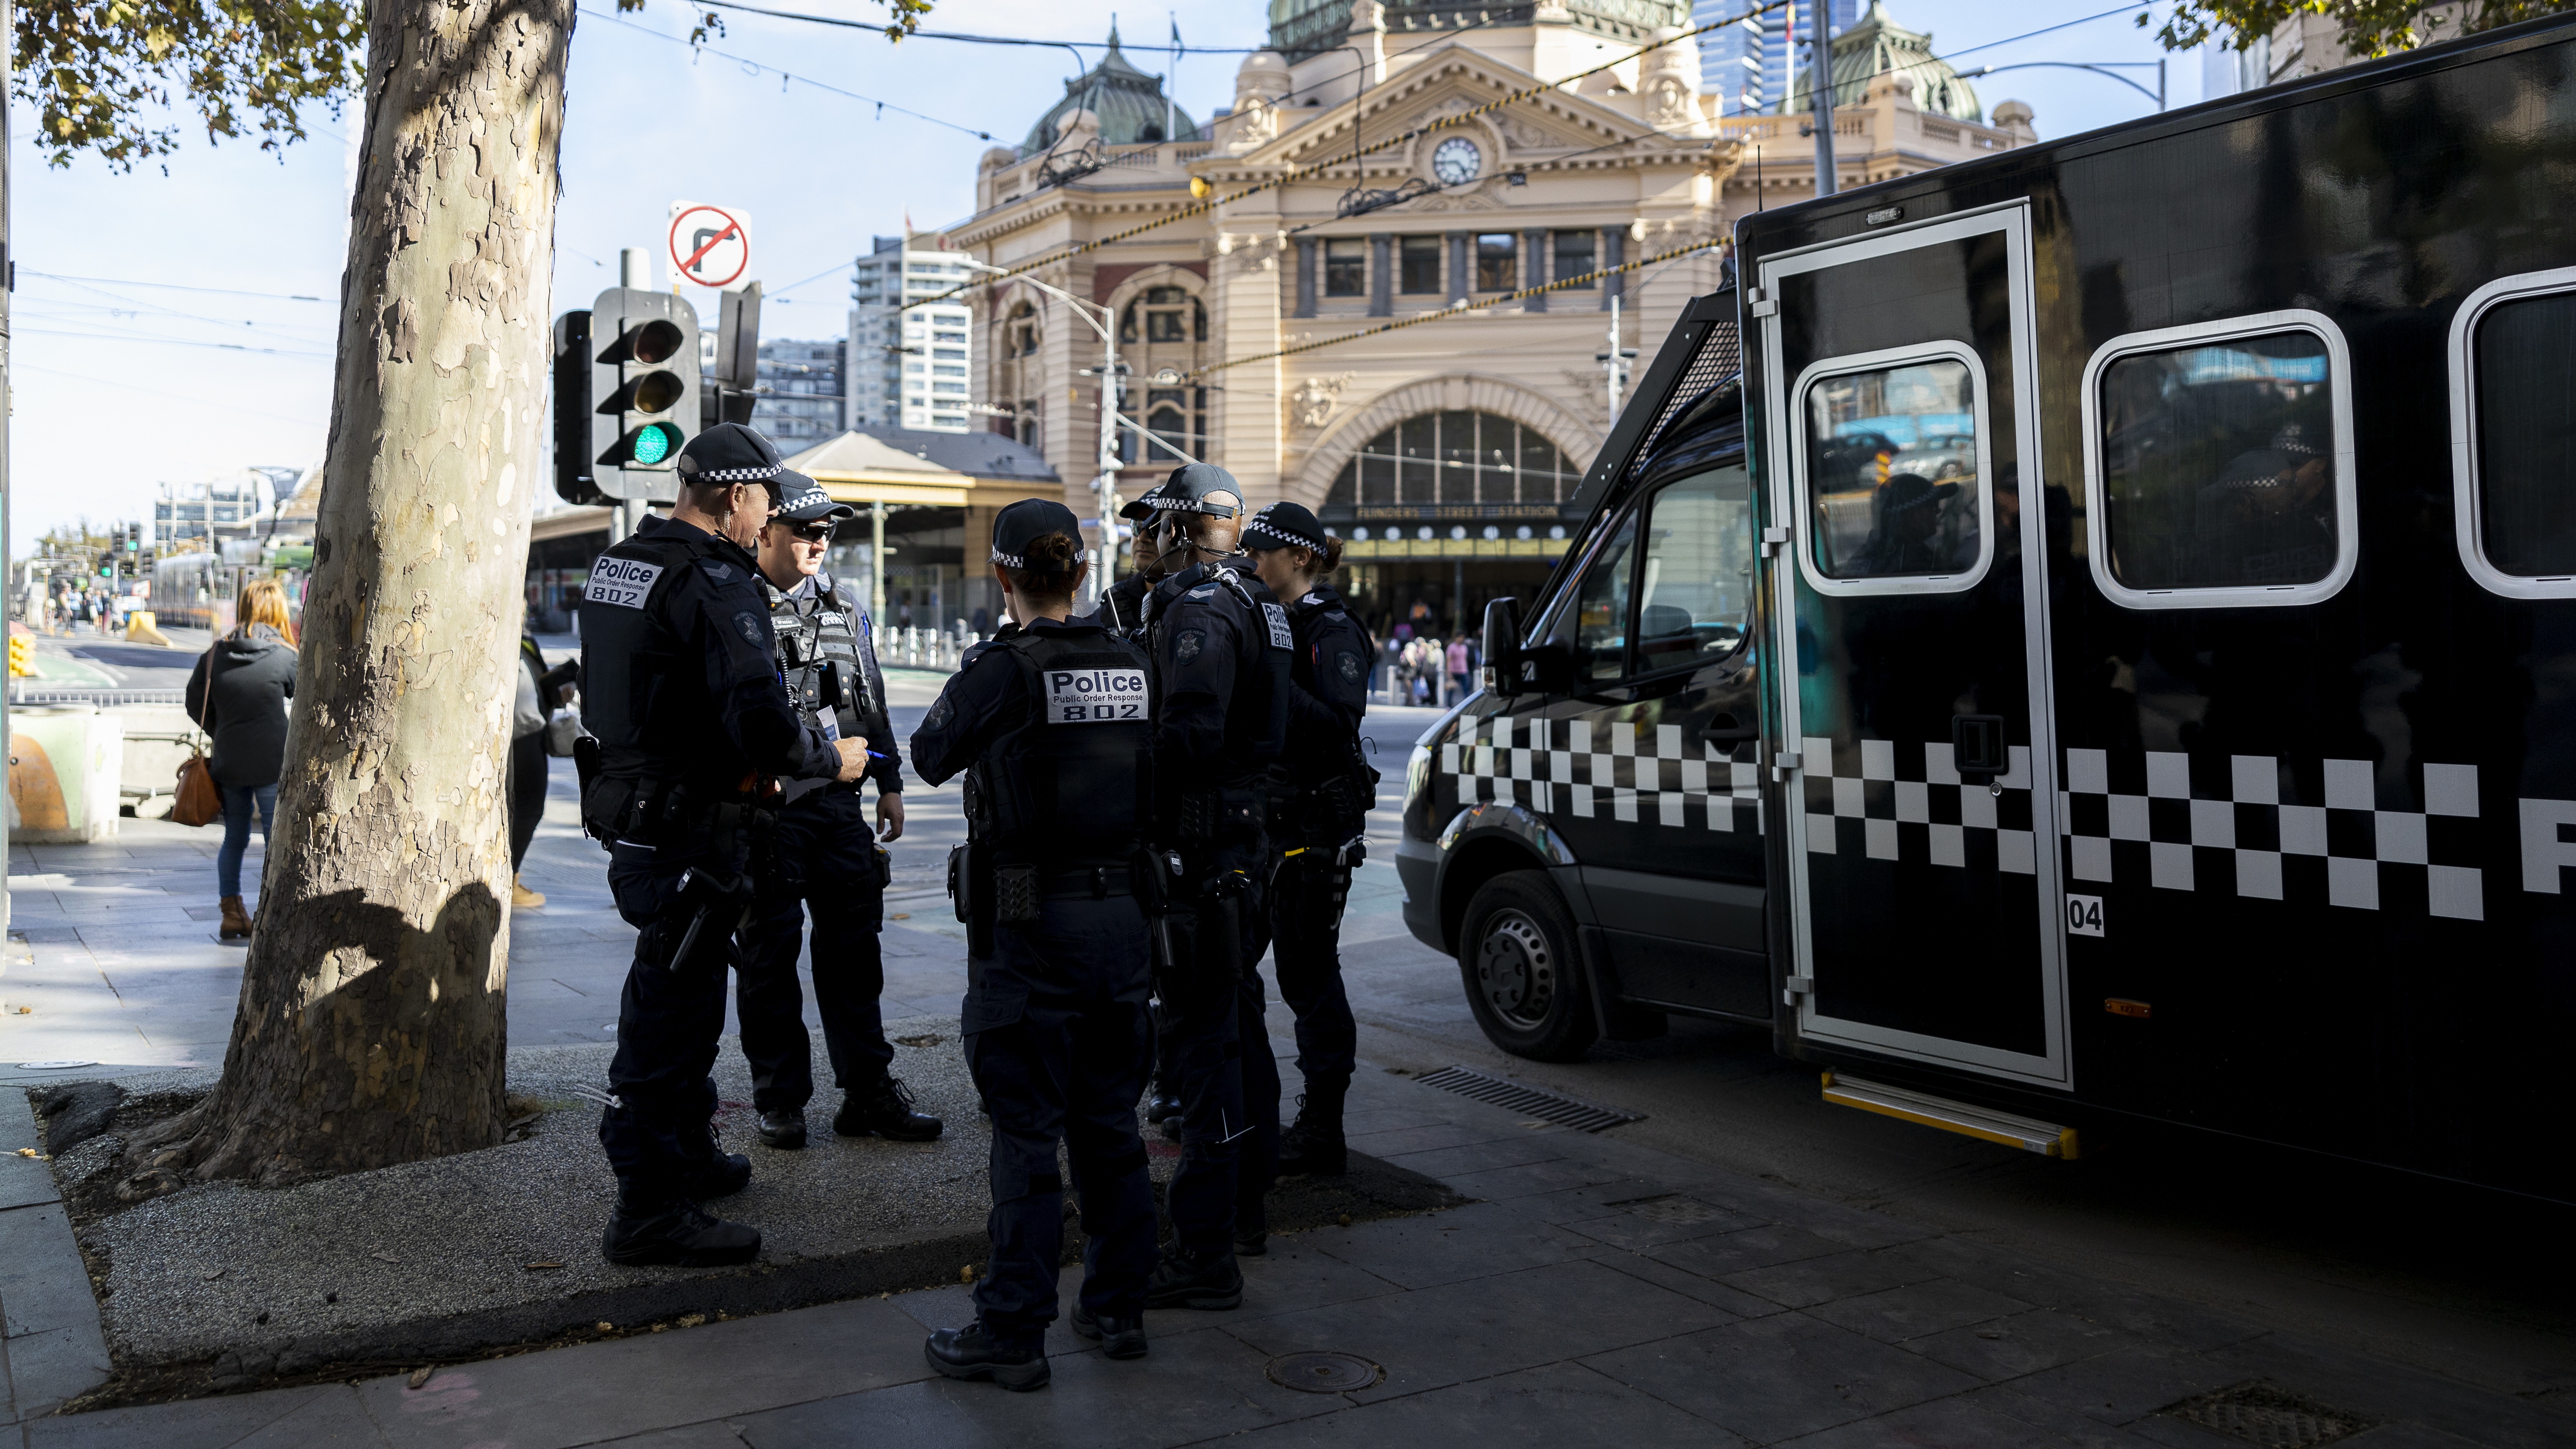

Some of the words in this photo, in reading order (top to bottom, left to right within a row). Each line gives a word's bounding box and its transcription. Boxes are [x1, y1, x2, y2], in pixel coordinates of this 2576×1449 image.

[595, 558, 654, 583] Police
[607, 579, 620, 587] Order
[620, 581, 645, 591] Response
[592, 586, 638, 606] 802
[734, 612, 748, 621] VICTORIA
[1177, 630, 1192, 638] VICTORIA
[1274, 632, 1291, 648] 802
[1051, 671, 1143, 694] Police
[1054, 695, 1081, 703] Public
[1107, 694, 1143, 702] Response
[1063, 704, 1139, 721] 802
[2069, 899, 2102, 931] 04
